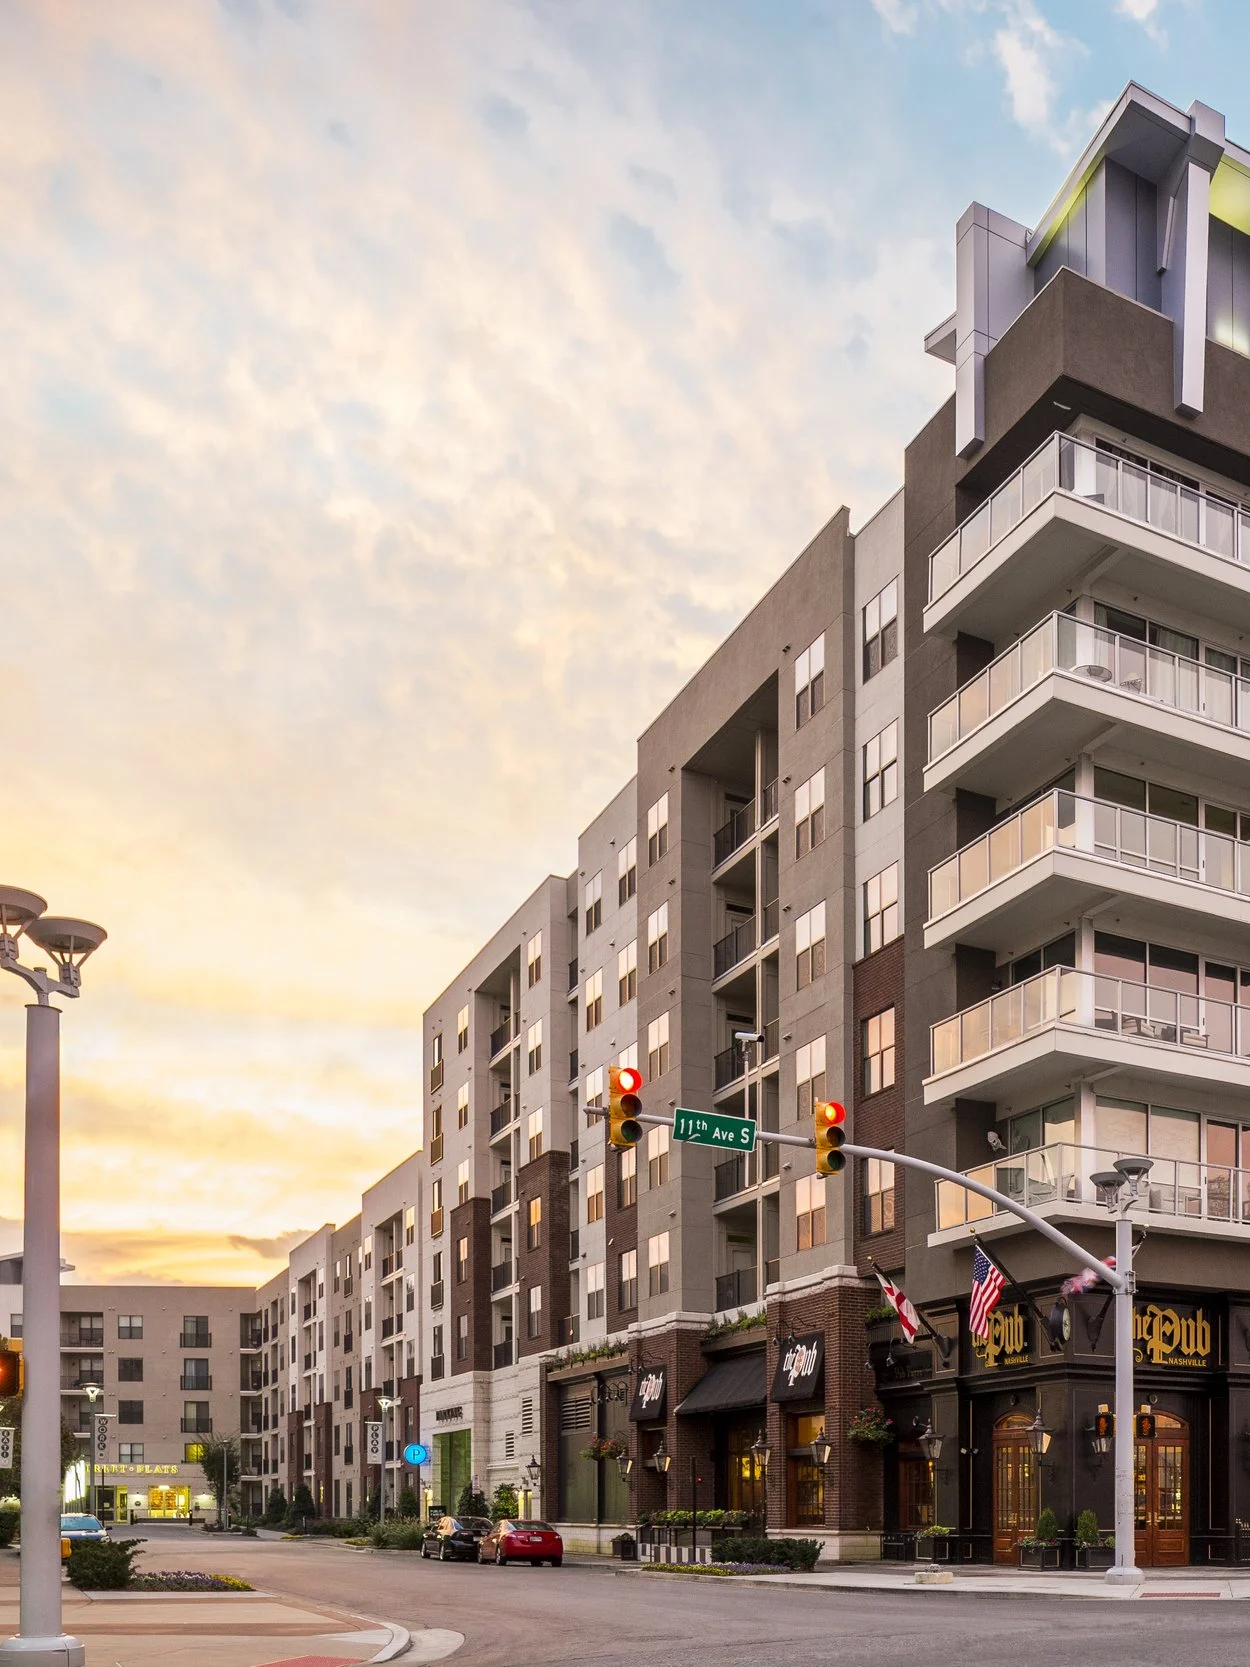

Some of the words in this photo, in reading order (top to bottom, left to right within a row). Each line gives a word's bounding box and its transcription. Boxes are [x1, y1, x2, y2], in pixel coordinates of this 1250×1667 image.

[680, 1118, 708, 1135] 11th
[712, 1127, 735, 1142] Ave
[740, 1127, 750, 1144] S
[985, 1303, 1024, 1368] Pub
[1133, 1306, 1152, 1341] he
[1147, 1304, 1211, 1365] Pub
[782, 1348, 796, 1372] the
[788, 1340, 818, 1387] Pub
[1005, 1355, 1029, 1365] NASHVILLE
[1168, 1357, 1207, 1367] NASHVILLE
[642, 1371, 664, 1409] Pub
[98, 1418, 107, 1450] WORK
[371, 1425, 379, 1453] PLAY
[412, 1449, 421, 1461] P
[136, 1464, 178, 1474] FLATS
